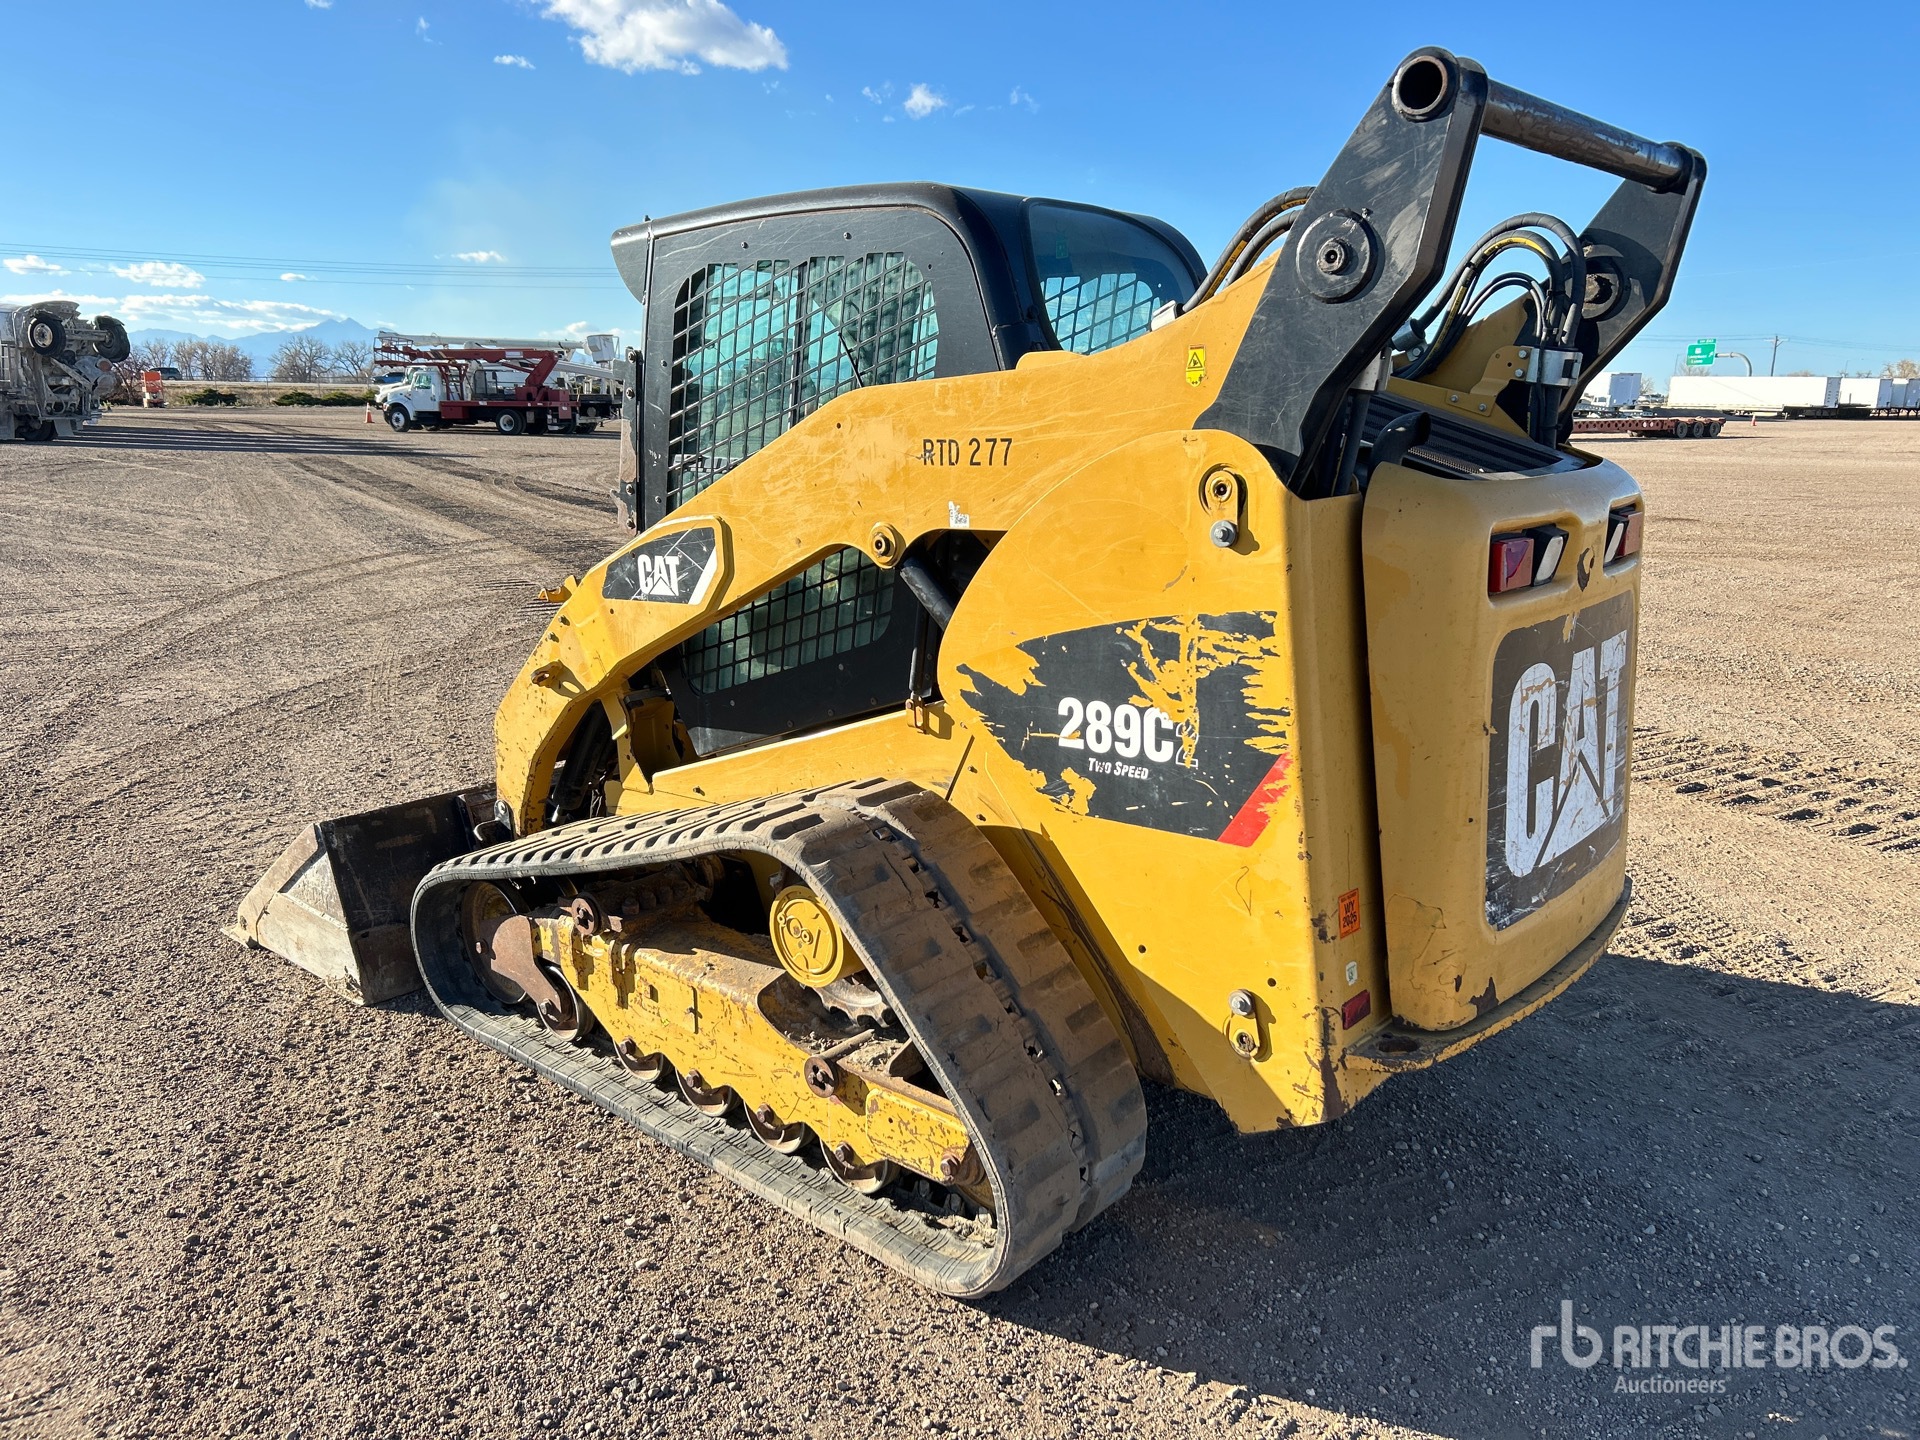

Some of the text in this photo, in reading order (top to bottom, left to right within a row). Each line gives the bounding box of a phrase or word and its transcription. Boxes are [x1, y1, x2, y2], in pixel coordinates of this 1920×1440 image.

[922, 438, 1013, 465] RTD 277
[637, 554, 680, 597] CAT
[1505, 629, 1627, 876] CAT
